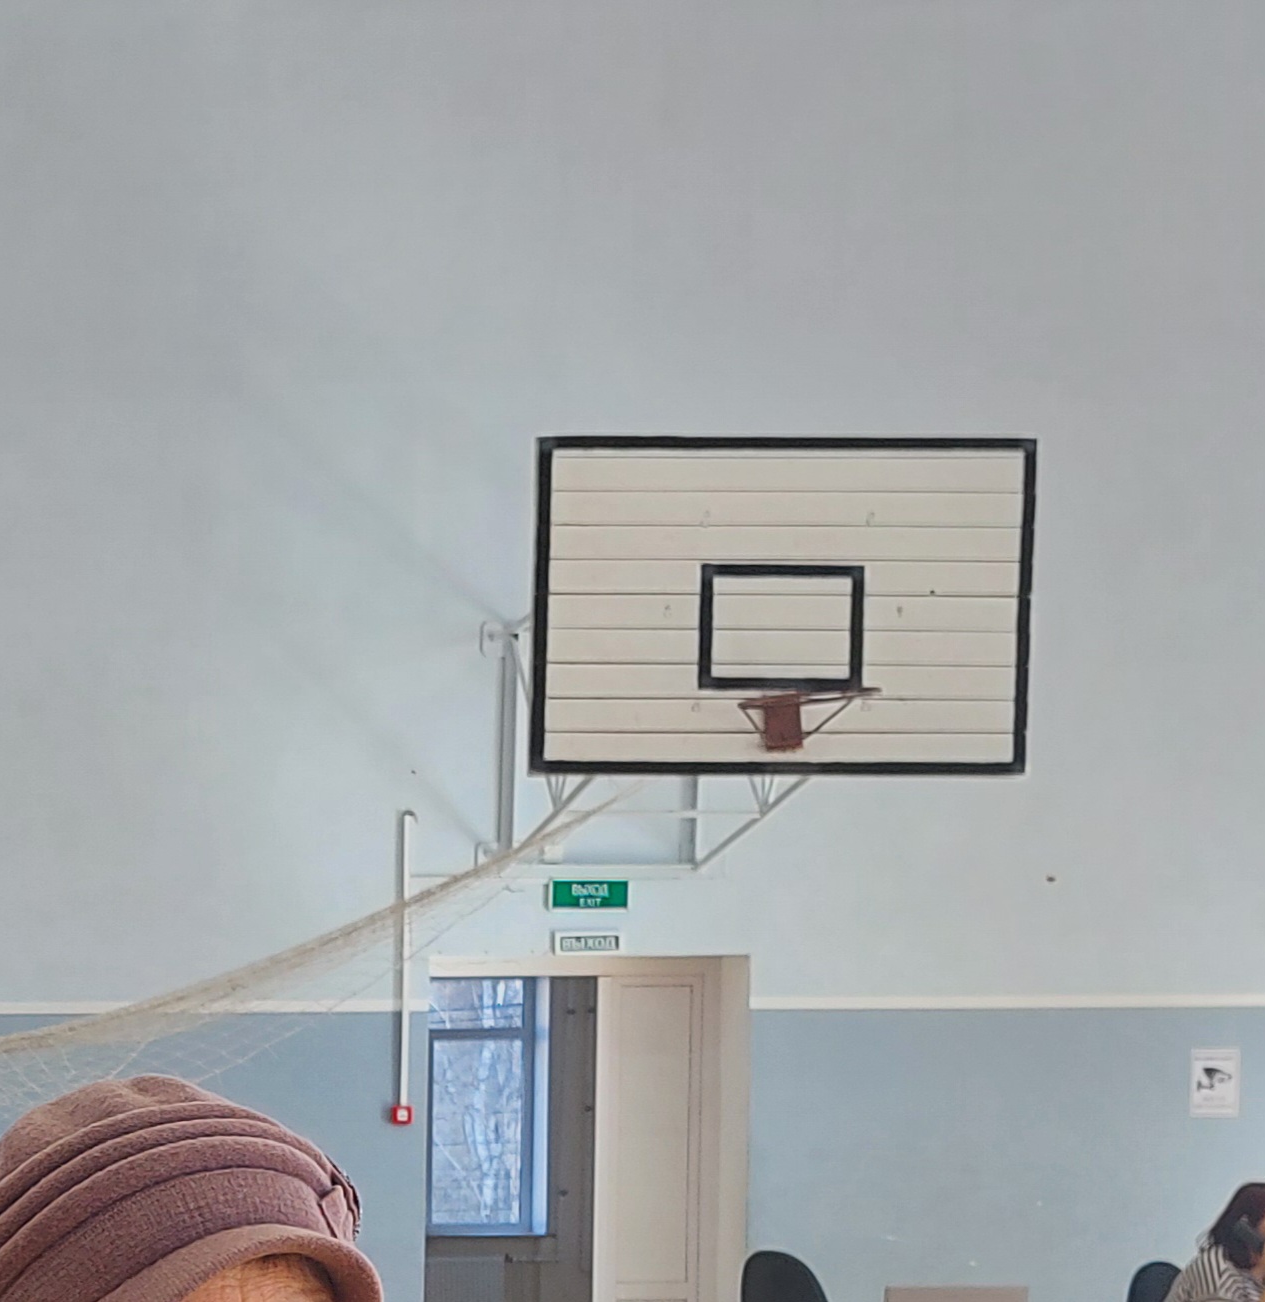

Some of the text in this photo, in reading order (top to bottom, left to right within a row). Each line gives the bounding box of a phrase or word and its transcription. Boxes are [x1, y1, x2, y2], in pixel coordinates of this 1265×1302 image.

[572, 883, 609, 897] ВЫХОД
[579, 898, 602, 907] EXIT
[562, 937, 616, 950] ВЫХОД
